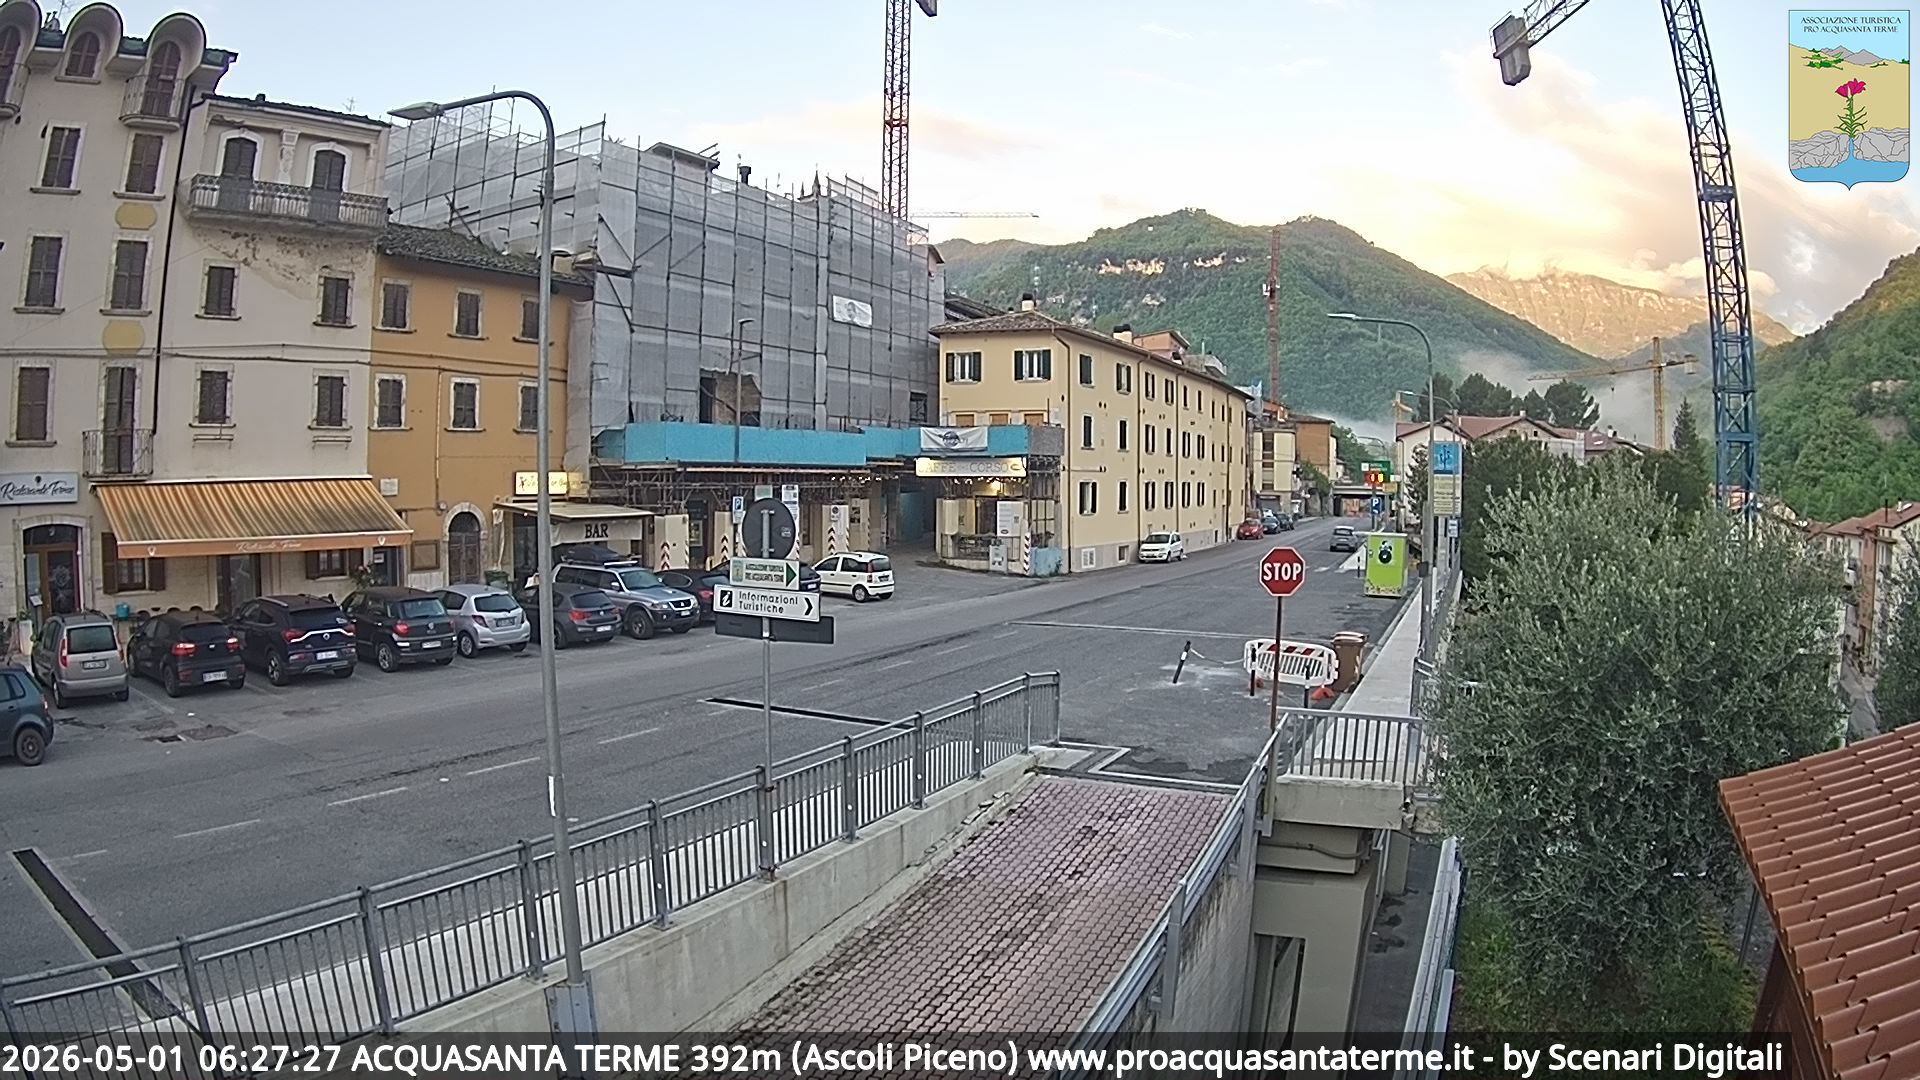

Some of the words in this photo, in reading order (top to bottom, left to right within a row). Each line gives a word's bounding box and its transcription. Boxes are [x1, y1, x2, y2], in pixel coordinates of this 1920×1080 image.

[969, 462, 1009, 474] CORSO
[584, 523, 609, 539] BAR
[1263, 562, 1302, 581] STOP
[739, 590, 798, 605] Informazioni
[739, 600, 784, 614] Turistiche
